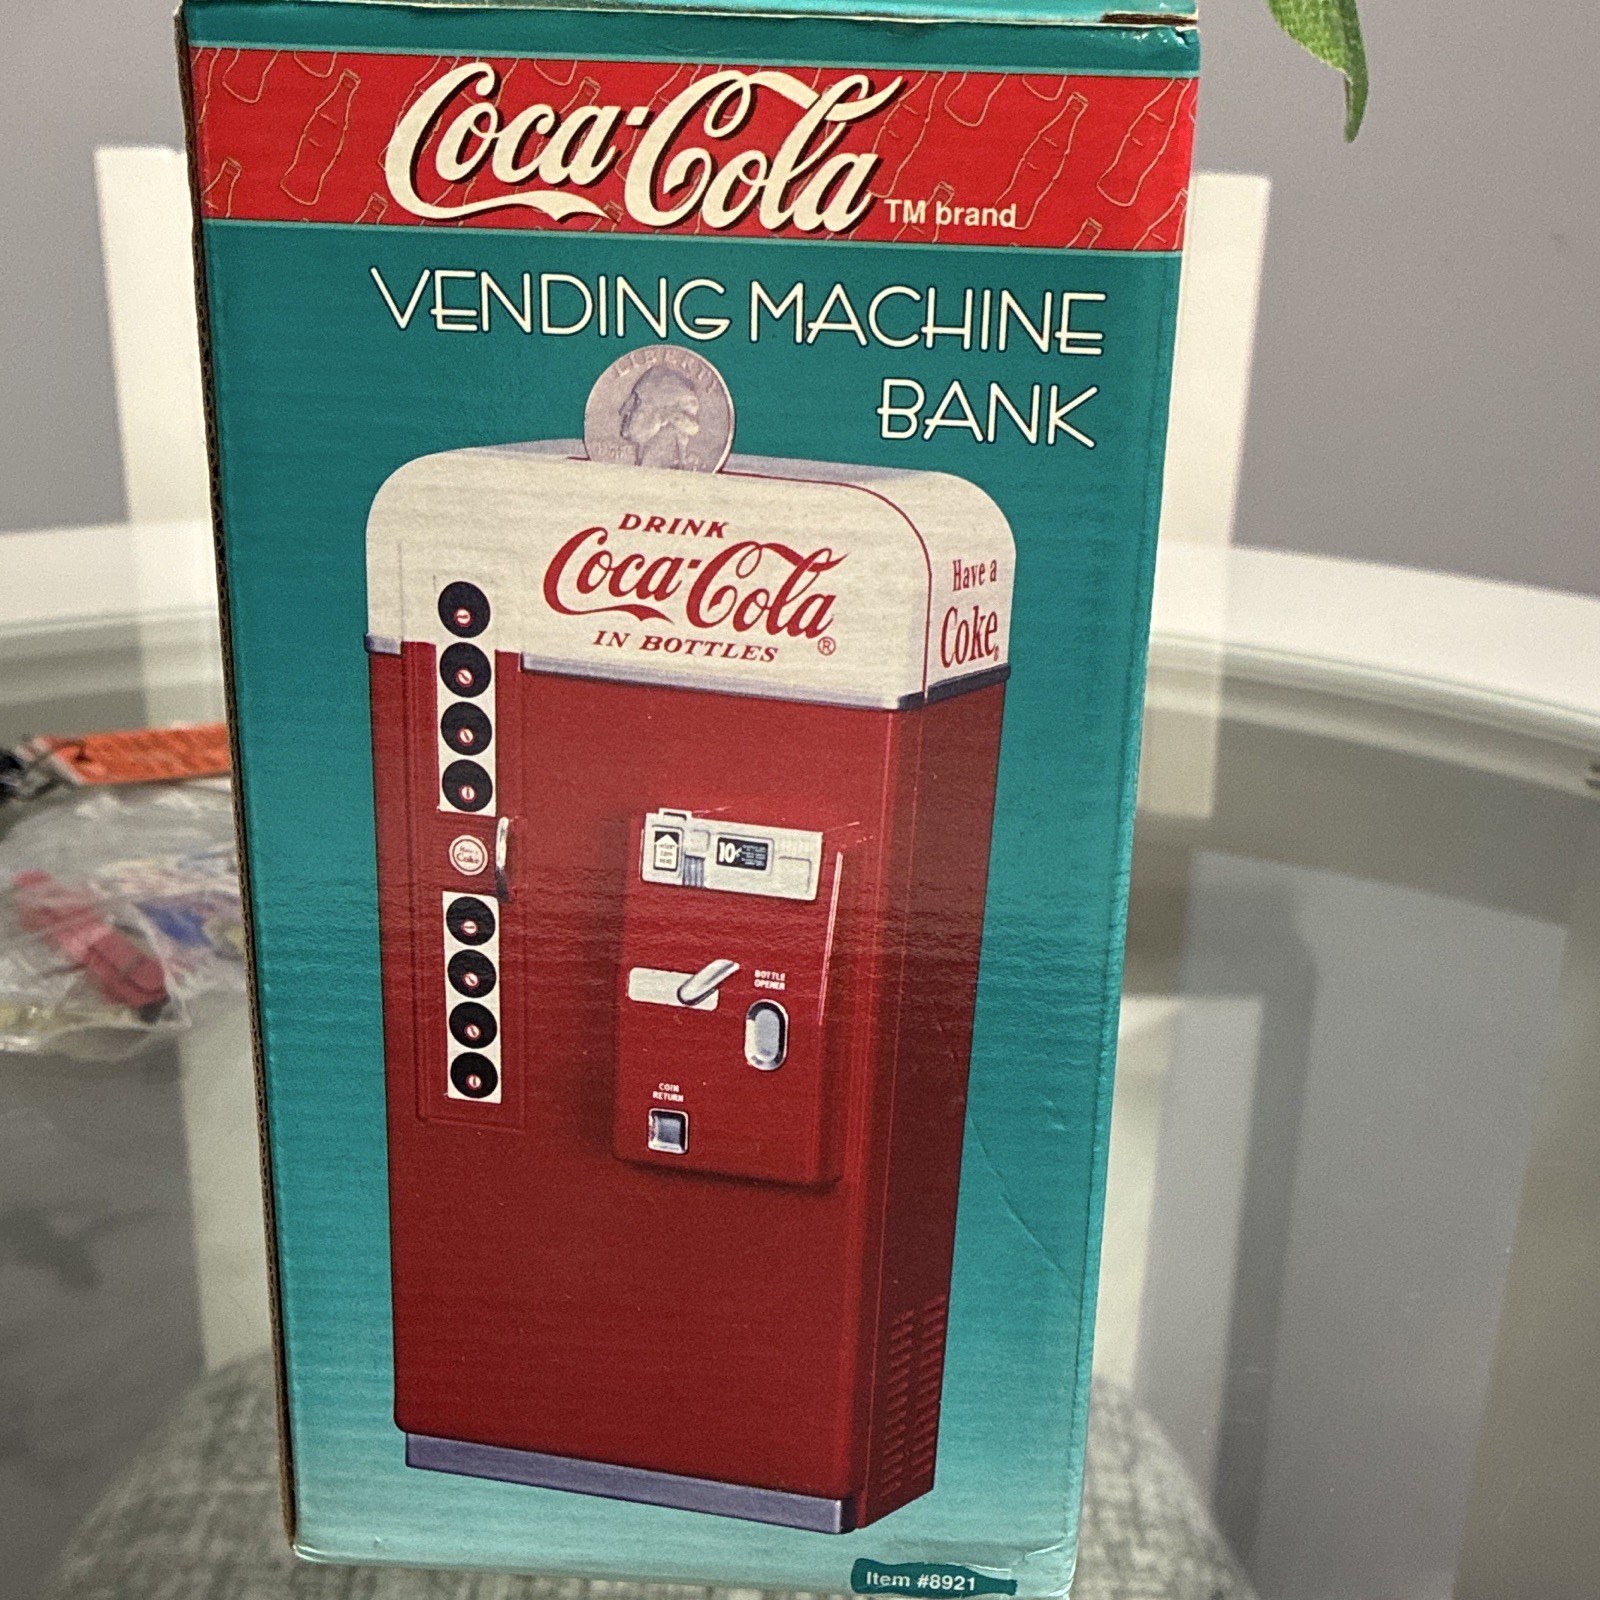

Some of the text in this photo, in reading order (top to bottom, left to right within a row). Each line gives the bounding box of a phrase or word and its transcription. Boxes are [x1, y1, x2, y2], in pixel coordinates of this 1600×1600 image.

[385, 62, 1016, 234] Coca-Cola TM brand
[368, 265, 1107, 357] VENDING MACHINE
[877, 378, 1099, 449] BANK
[617, 512, 731, 540] DRINK
[543, 526, 848, 640] Coca-Cola
[951, 558, 998, 592] Have a
[593, 630, 779, 664] IN BOTTLES
[940, 604, 998, 669] Coke
[754, 969, 786, 982] BOTTLE
[754, 979, 786, 991] OPENER
[652, 1090, 684, 1103] RETURN
[658, 1082, 680, 1093] COIN
[865, 1570, 976, 1592] Item #8921
